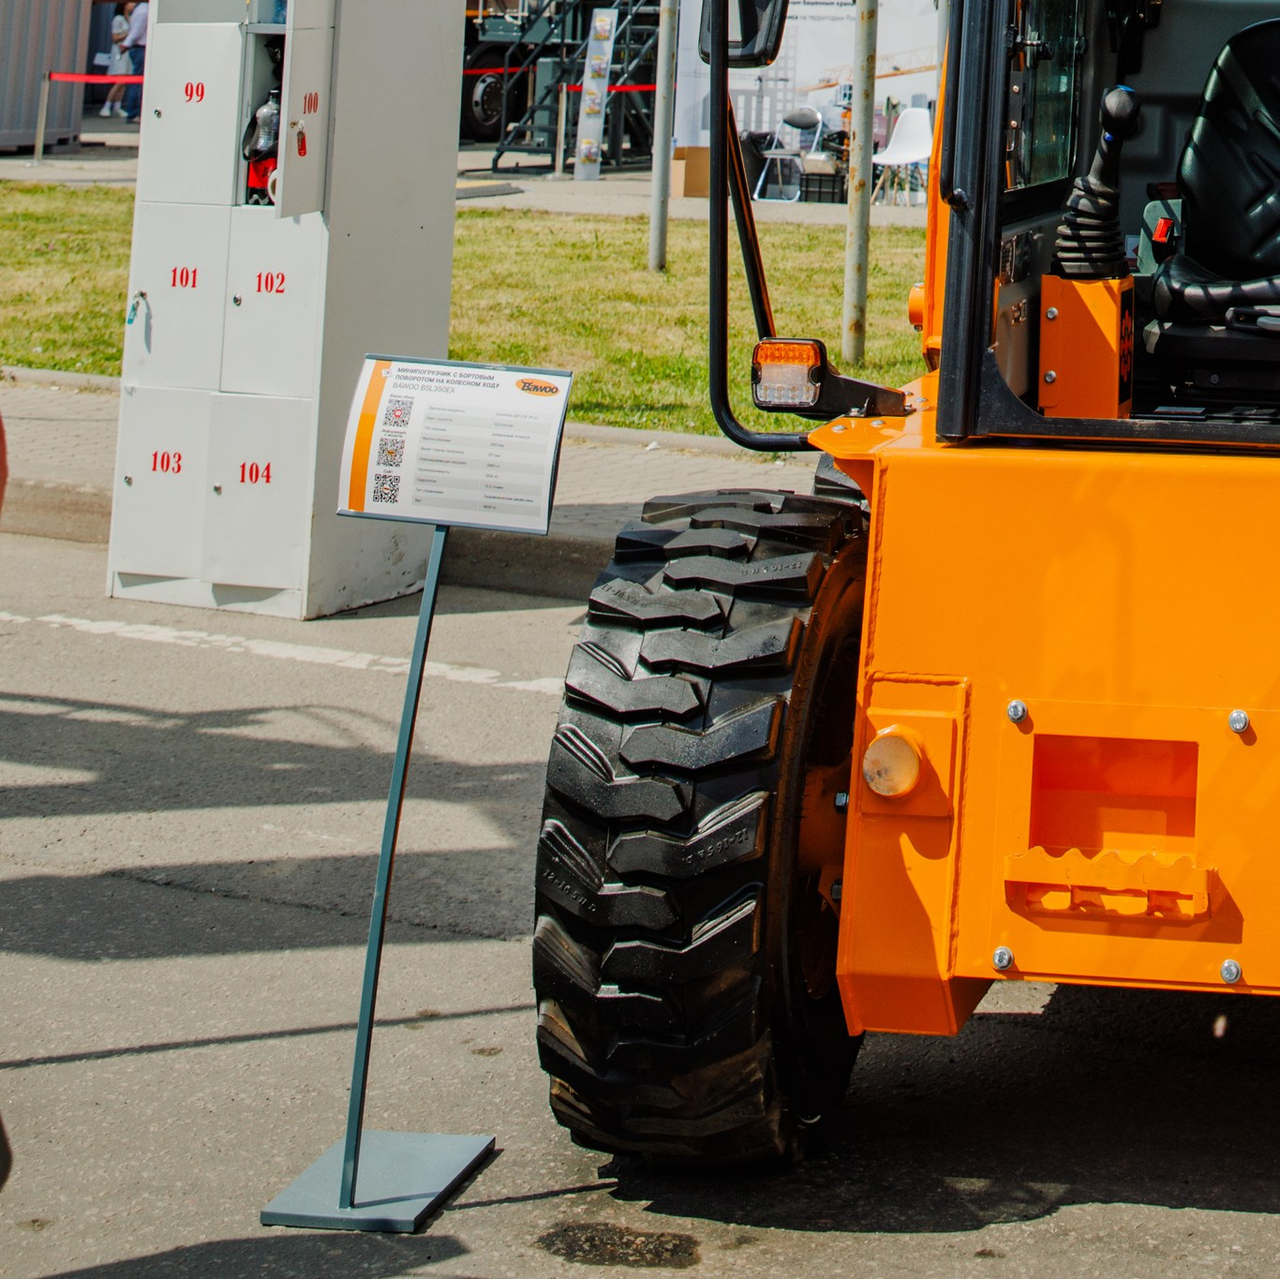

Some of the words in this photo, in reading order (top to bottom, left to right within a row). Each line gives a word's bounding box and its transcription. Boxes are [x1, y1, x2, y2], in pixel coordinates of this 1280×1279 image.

[184, 81, 205, 103] 99
[302, 91, 319, 115] 100
[170, 266, 198, 288] 101
[256, 271, 286, 294] 102
[392, 381, 419, 391] BAWOO
[395, 374, 435, 383] ПОВОРОТОМ
[446, 379, 481, 388] КОЛЕСНОМ
[458, 373, 495, 381] БОРТОВЫМ
[520, 379, 560, 395] Bawoo
[151, 450, 182, 474] 103
[239, 461, 272, 484] 104
